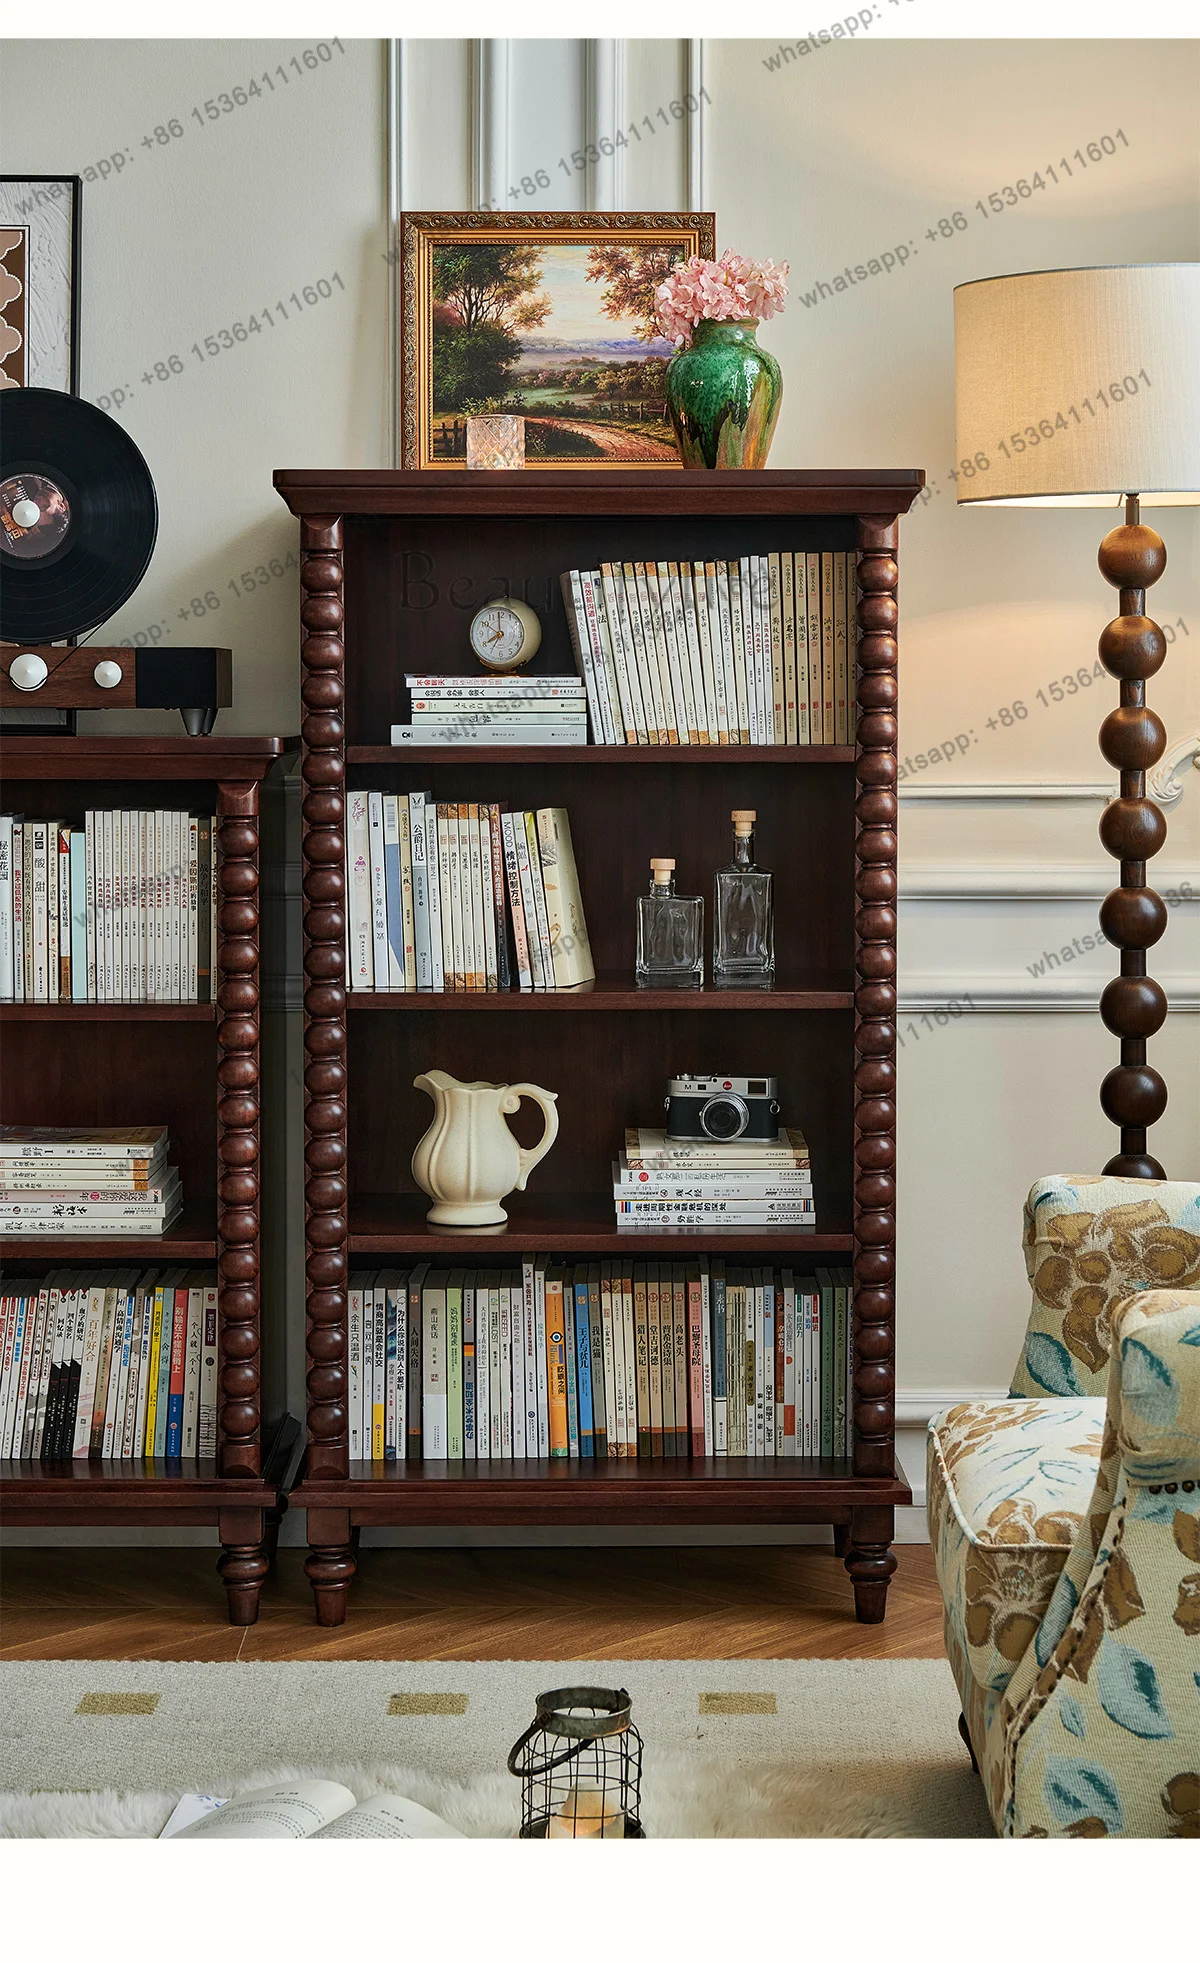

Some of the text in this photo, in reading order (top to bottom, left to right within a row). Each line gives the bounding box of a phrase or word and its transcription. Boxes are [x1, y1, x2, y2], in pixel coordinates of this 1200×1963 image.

[412, 823, 425, 862] 公爵日记
[503, 821, 513, 848] MOOD
[505, 849, 521, 907] 情绪控制方法
[634, 1202, 727, 1212] 走进周期性金融危机的深处
[430, 1307, 439, 1340] 燕山夜话
[714, 1293, 726, 1314] 素书
[86, 1319, 99, 1362] 百年好合
[161, 1341, 170, 1365] 舍得
[172, 1306, 184, 1374] 别输在不懂营销上
[188, 1315, 200, 1376] 一个人就一个人
[350, 1313, 360, 1362] 余生只温酒
[374, 1302, 384, 1368] 情商高就是会社交
[396, 1309, 406, 1391] 为什么你说话别人不爱听
[410, 1326, 420, 1369] 人间失格
[578, 1326, 589, 1369] 王子与贫儿
[591, 1325, 601, 1359] 我是猫
[636, 1324, 647, 1367] 猎人笔记
[649, 1324, 660, 1366] 堂吉诃德
[662, 1324, 672, 1367] 普希金诗集
[675, 1323, 685, 1358] 高老头
[691, 1324, 702, 1367] 巴黎圣母院
[465, 1381, 475, 1441] 办事艺术全知道
